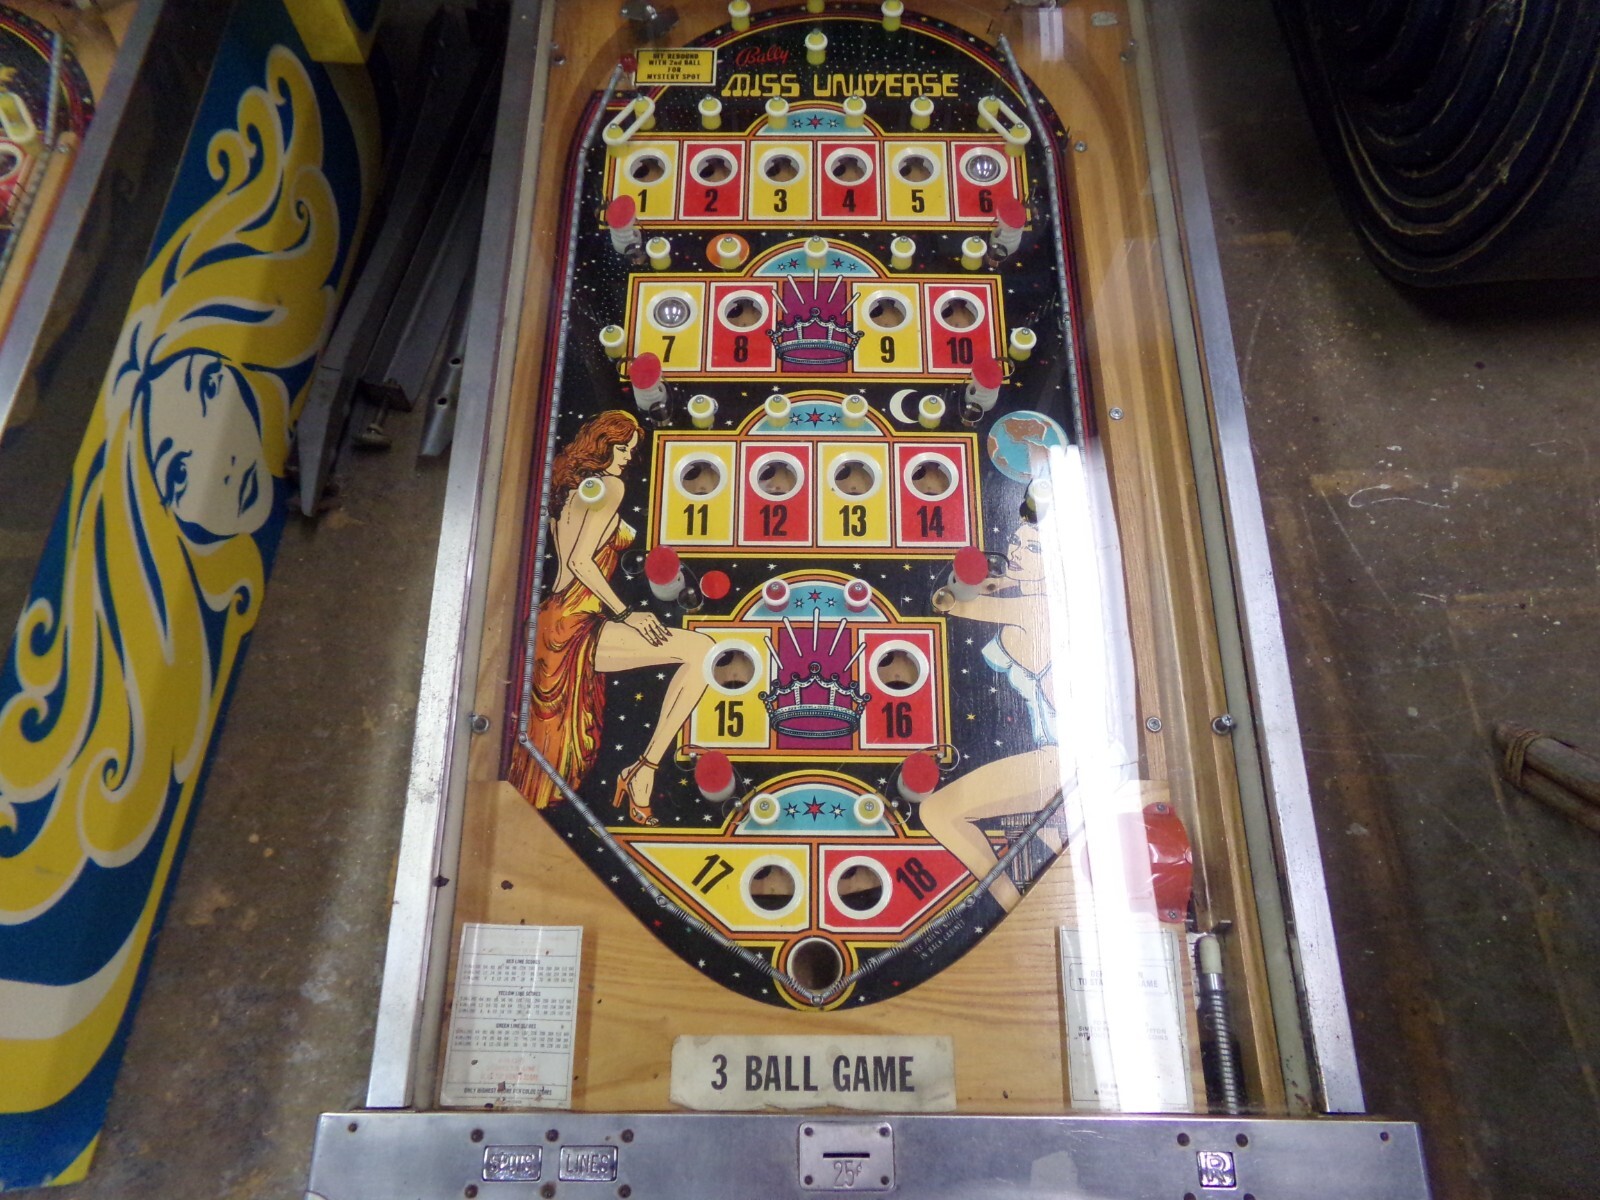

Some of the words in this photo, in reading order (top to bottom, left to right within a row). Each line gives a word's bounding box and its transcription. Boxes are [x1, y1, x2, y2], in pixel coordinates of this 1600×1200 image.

[735, 44, 789, 66] Bally
[720, 73, 800, 97] MISS
[813, 73, 959, 97] UNIVERSE
[637, 189, 648, 213] 1
[704, 189, 719, 213] 2
[773, 189, 788, 213] 3
[841, 189, 857, 213] 4
[910, 189, 926, 213] 5
[978, 189, 993, 213] 6
[661, 335, 676, 363] 7
[733, 335, 749, 363] 8
[880, 335, 896, 363] 9
[946, 336, 974, 365] 10
[683, 503, 709, 536] 11
[759, 504, 788, 537] 12
[838, 504, 867, 537] 13
[916, 505, 945, 538] 14
[714, 700, 744, 738] 15
[881, 701, 913, 739] 16
[691, 853, 735, 895] 17
[896, 856, 938, 901] 18
[710, 1053, 728, 1091] 3
[745, 1055, 819, 1092] BALL
[832, 1055, 915, 1093] GAME
[565, 1152, 611, 1174] LINES
